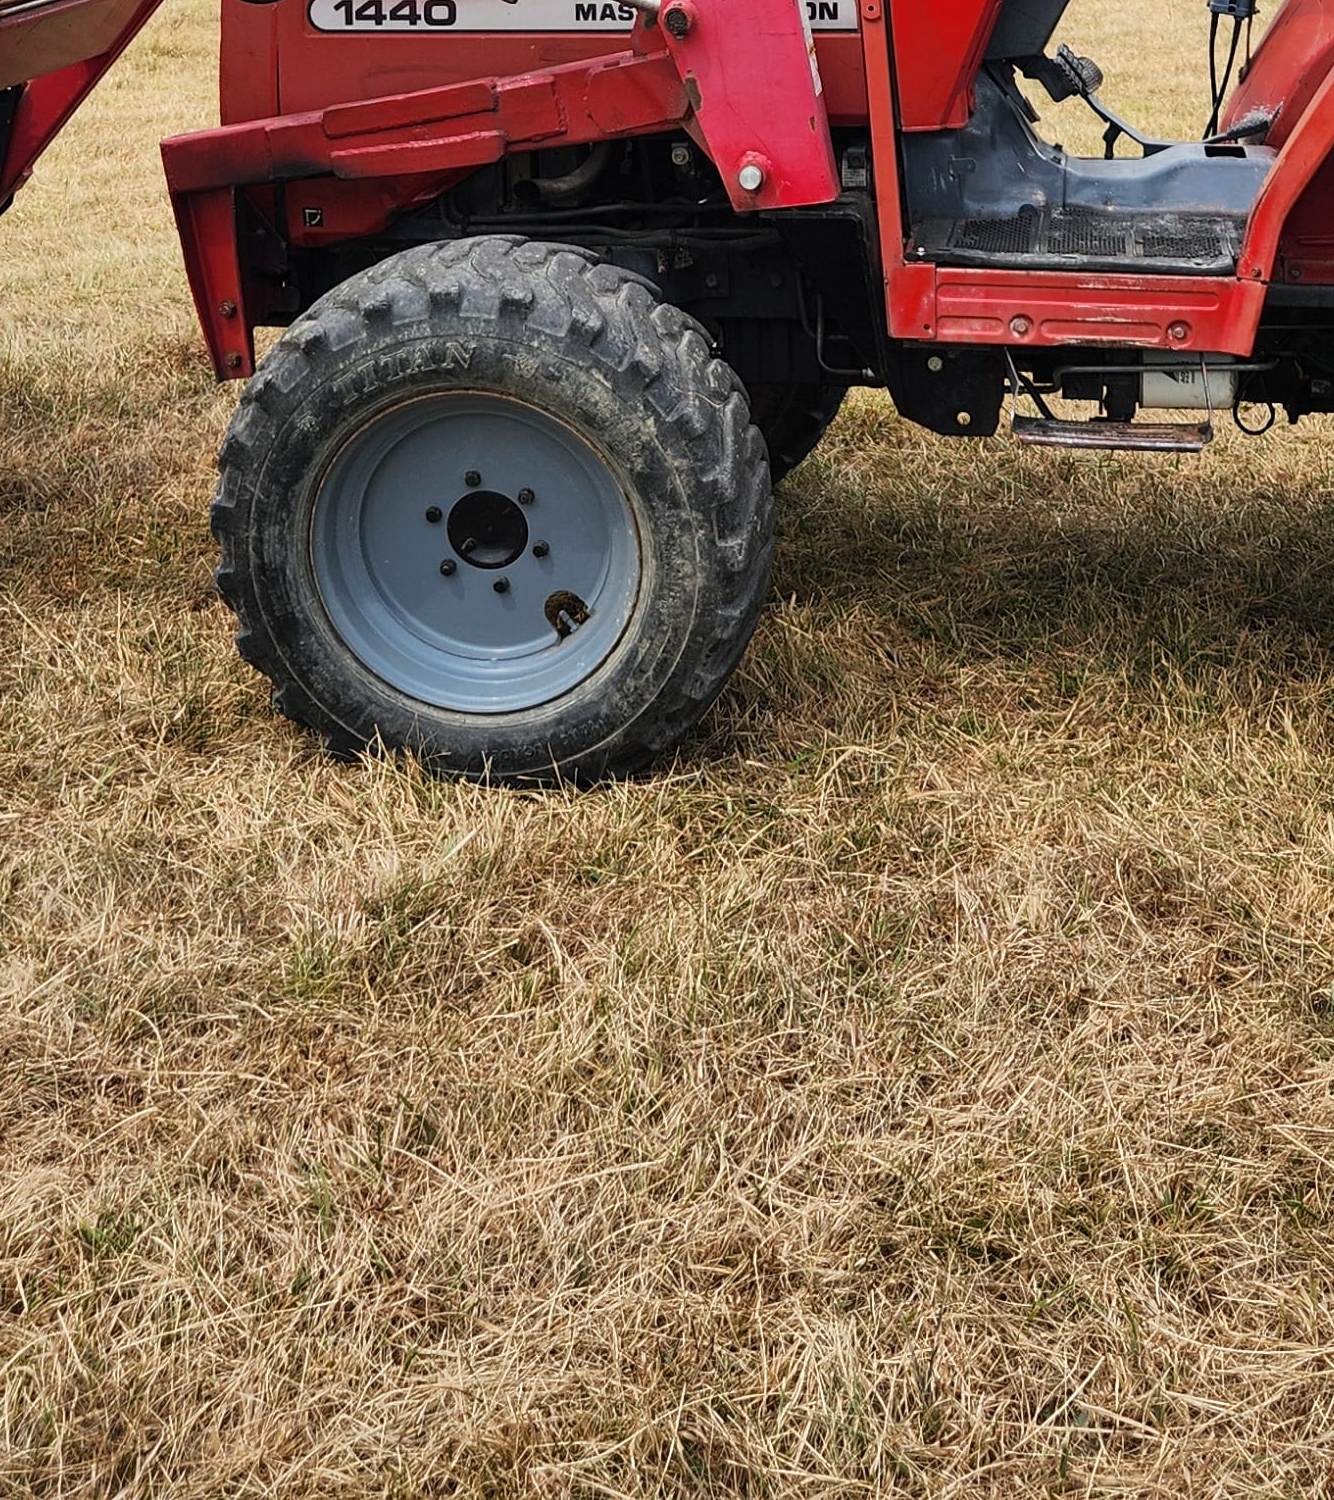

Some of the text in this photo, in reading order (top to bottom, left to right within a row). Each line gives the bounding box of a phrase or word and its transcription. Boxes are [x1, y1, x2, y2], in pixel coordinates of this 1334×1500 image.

[334, 0, 457, 26] 1440
[575, 3, 635, 21] MAS
[332, 341, 476, 405] TITAN
